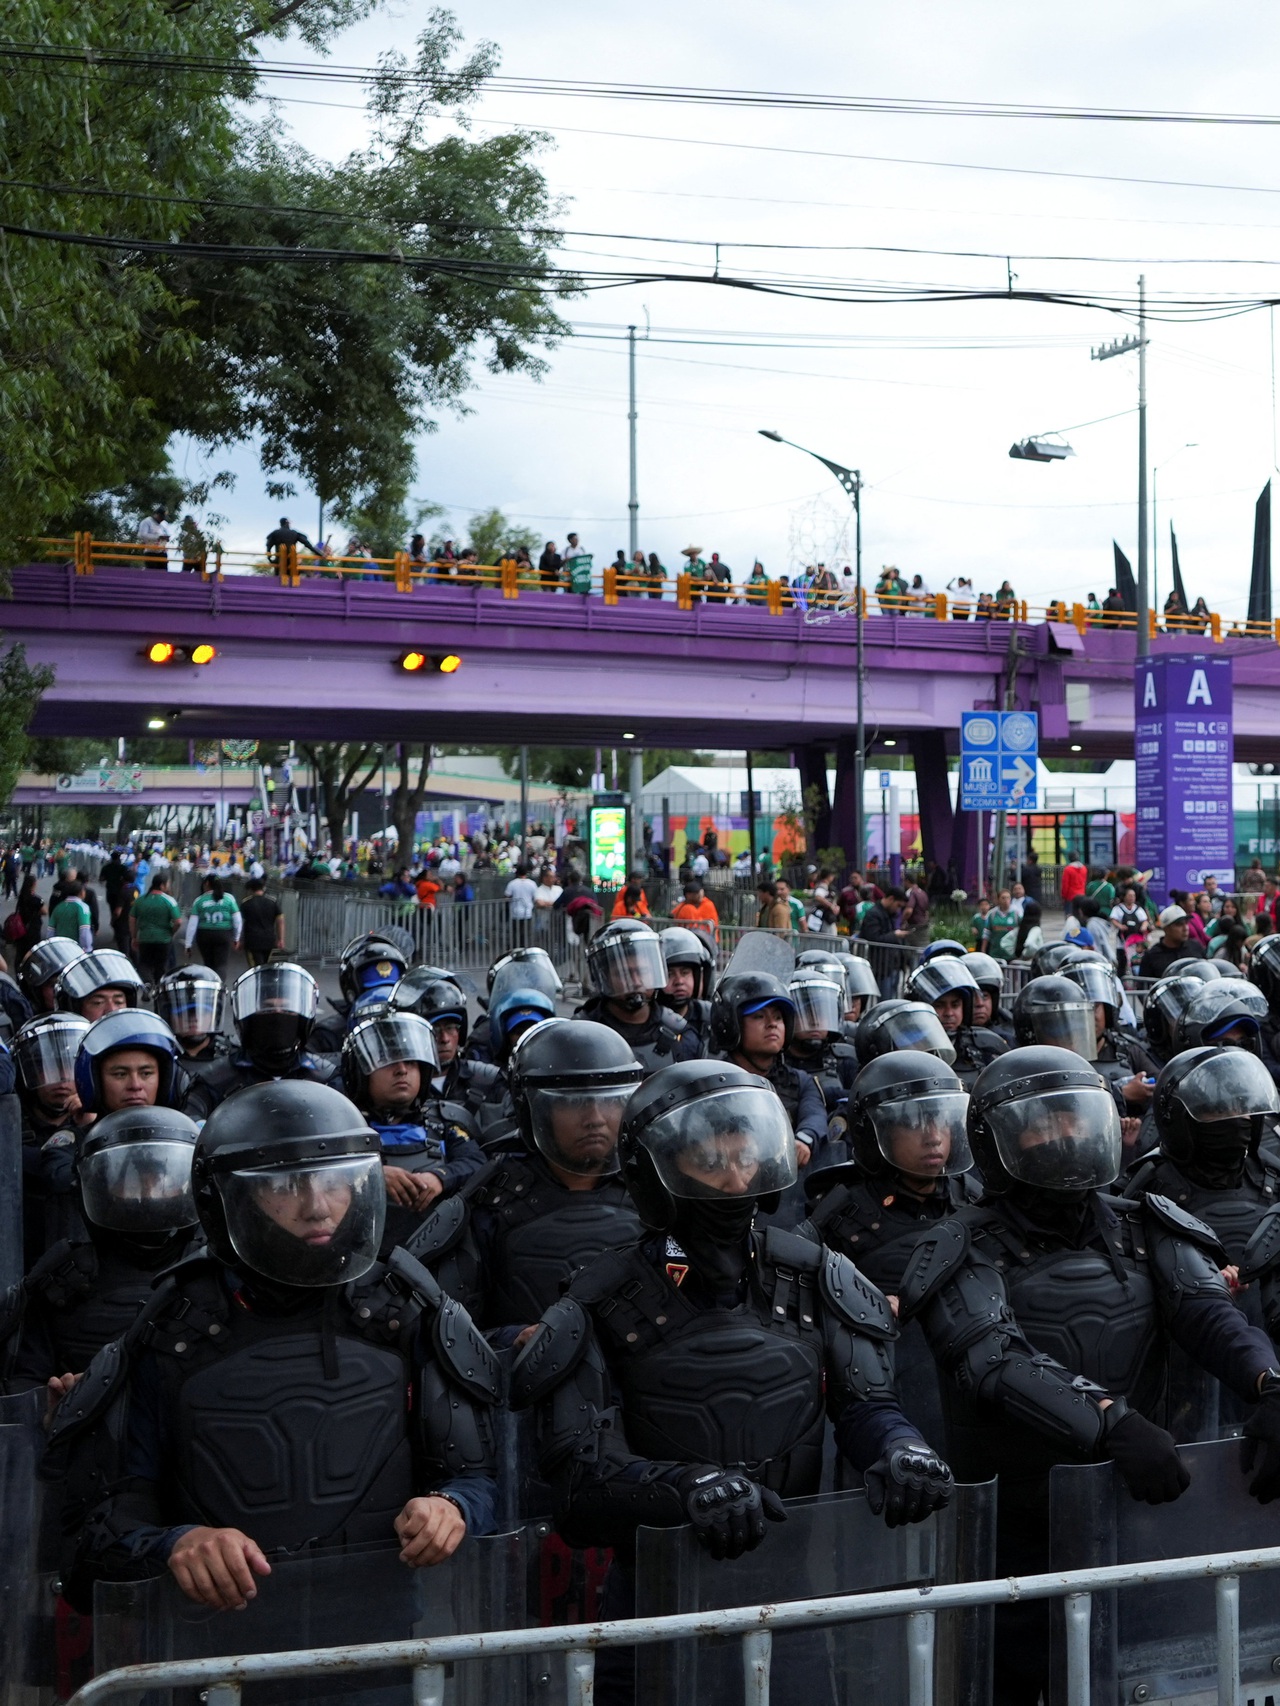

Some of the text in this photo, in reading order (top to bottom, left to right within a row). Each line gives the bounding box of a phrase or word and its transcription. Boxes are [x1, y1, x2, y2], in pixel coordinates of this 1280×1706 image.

[1143, 672, 1157, 708] A
[1186, 669, 1213, 705] A
[964, 783, 997, 794] MUSEO
